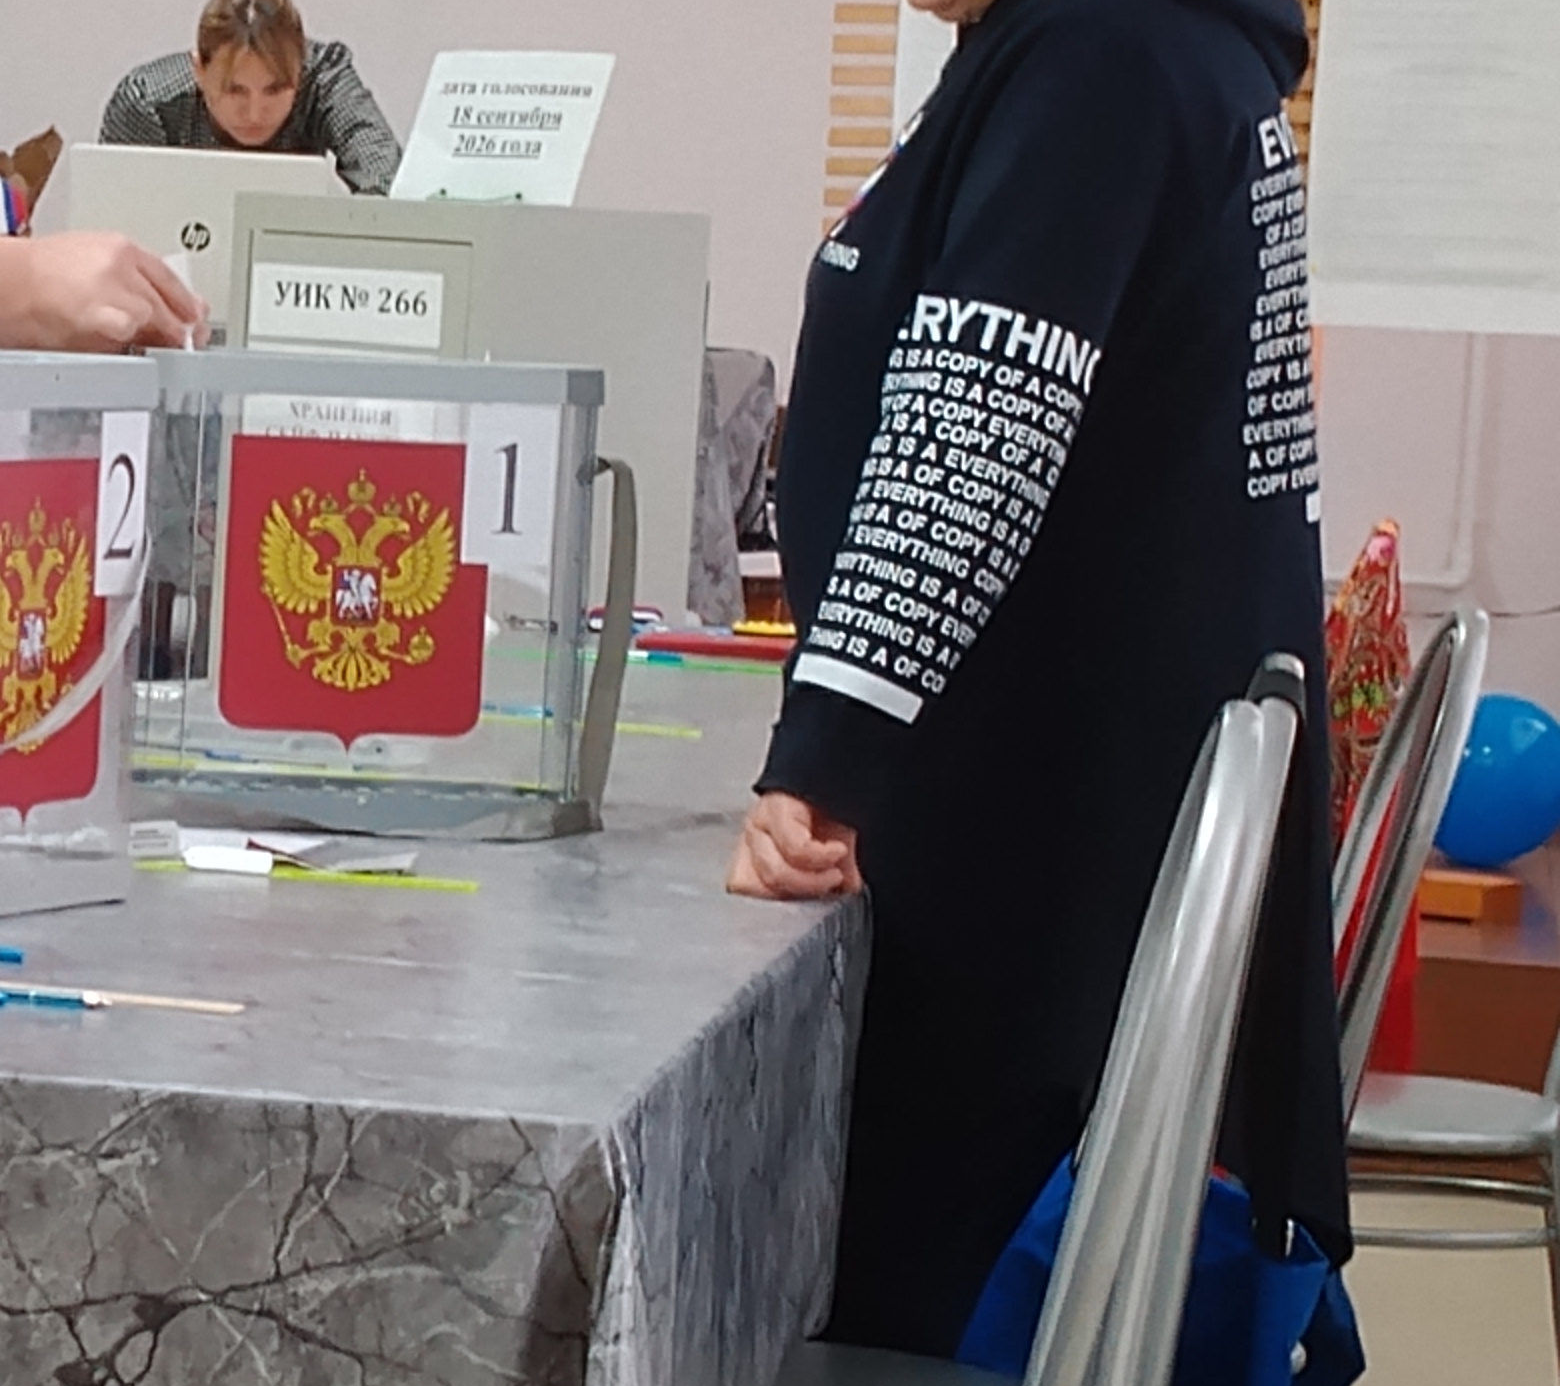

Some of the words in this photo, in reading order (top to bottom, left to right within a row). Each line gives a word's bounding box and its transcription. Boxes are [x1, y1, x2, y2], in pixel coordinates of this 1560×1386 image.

[481, 81, 593, 98] голосования
[452, 105, 473, 124] 18
[476, 106, 563, 129] сентября
[454, 134, 496, 153] 2026
[499, 139, 542, 155] года
[181, 221, 211, 252] hp
[274, 280, 333, 310] УИК
[340, 285, 370, 313] №
[377, 288, 428, 317] 266
[897, 293, 1102, 396] RYTHIN
[935, 348, 993, 379] COPY
[994, 364, 1025, 388] OF
[1024, 375, 1040, 397] A
[1246, 364, 1282, 390] COPY
[910, 394, 926, 415] A
[928, 397, 989, 429] COPY
[944, 375, 967, 398] IS
[965, 382, 983, 404] A
[987, 388, 1045, 423] COPY
[1043, 410, 1067, 434] OF
[1247, 393, 1268, 417] OF
[897, 435, 917, 457] IS
[919, 441, 938, 462] A
[910, 415, 928, 436] A
[935, 421, 995, 454] COPY
[1001, 441, 1030, 466] OF
[1027, 456, 1043, 478] A
[1249, 449, 1263, 471] A
[1265, 444, 1287, 468] OF
[492, 442, 522, 536] 1
[892, 460, 907, 480] A
[914, 463, 945, 487] OF
[948, 474, 1007, 511] COPY
[1005, 497, 1023, 521] IS
[1020, 508, 1034, 528] A
[1247, 473, 1288, 499] COPY
[103, 452, 136, 560] 2
[872, 478, 990, 533] EVERYTHING
[991, 518, 1009, 542] IS
[1006, 528, 1020, 549] A
[875, 504, 890, 525] A
[896, 509, 929, 532] OF
[930, 520, 987, 557] COPY
[854, 523, 971, 580] EVERYTHING
[837, 578, 851, 597] A
[853, 580, 883, 604] OF
[884, 591, 942, 629] COPY
[919, 574, 942, 599] IS
[941, 587, 958, 609] A
[846, 635, 870, 658] IS
[869, 646, 887, 667] A
[893, 654, 922, 679] OF
[915, 633, 937, 657] IS
[936, 645, 951, 666] A
